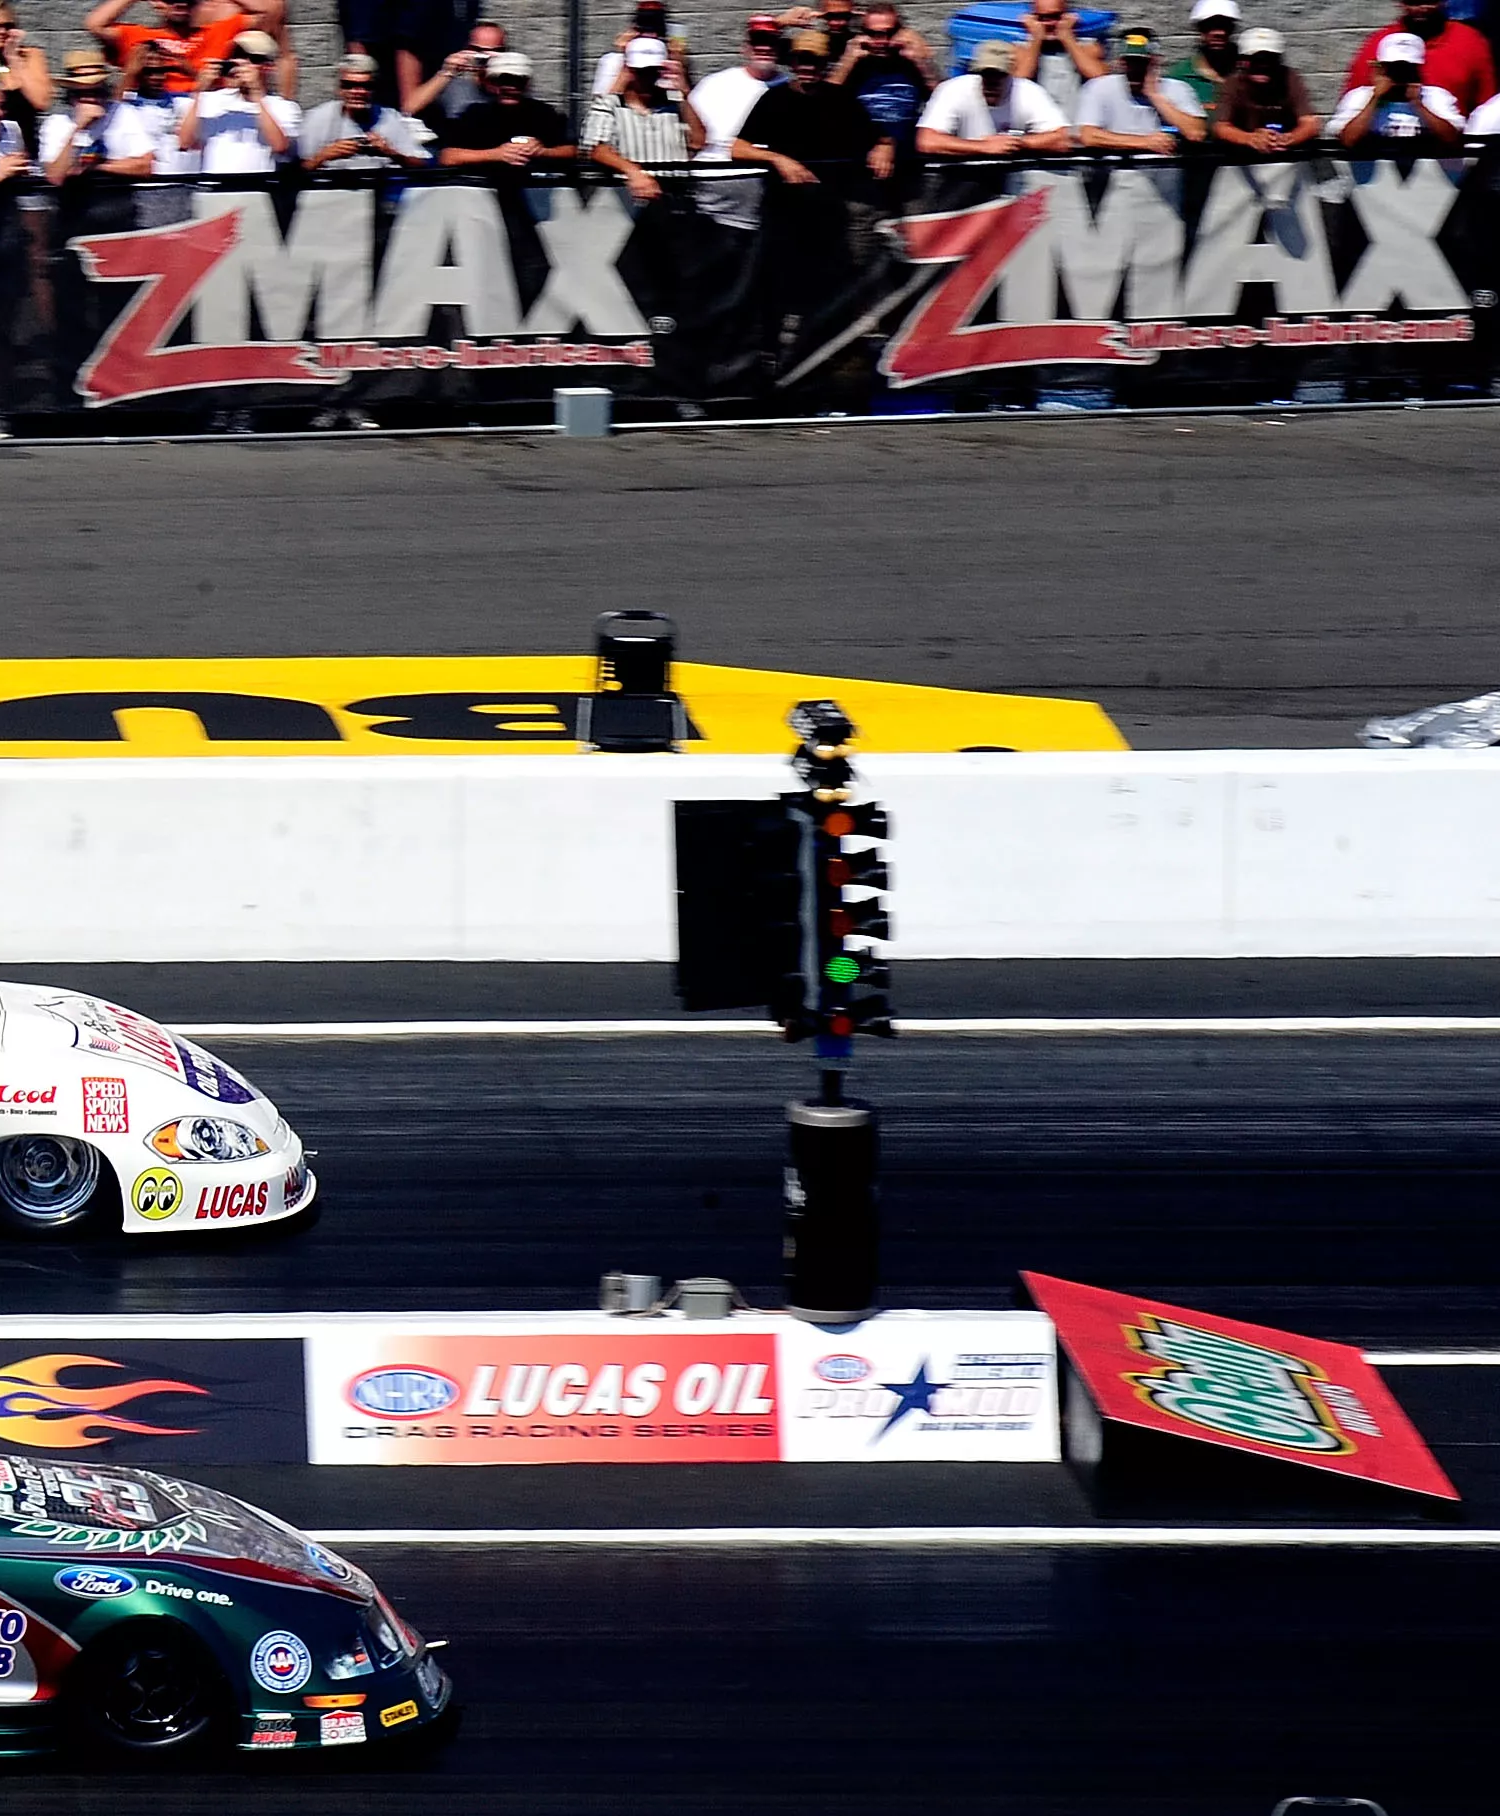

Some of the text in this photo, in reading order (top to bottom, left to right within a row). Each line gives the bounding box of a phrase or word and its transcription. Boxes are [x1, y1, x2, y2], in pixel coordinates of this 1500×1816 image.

[84, 1081, 125, 1098] SPEED
[85, 1098, 125, 1115] SPORT
[86, 1115, 126, 1132] NEWS
[195, 1182, 269, 1219] LUCAS
[462, 1363, 774, 1418] LUCAS OIL
[342, 1423, 775, 1440] DRAG RACING SERIES
[71, 1569, 234, 1606] Ford Drive one.
[322, 1716, 363, 1728] BRAND
[252, 1731, 297, 1743] HIGH
[321, 1727, 365, 1740] SOURCE
